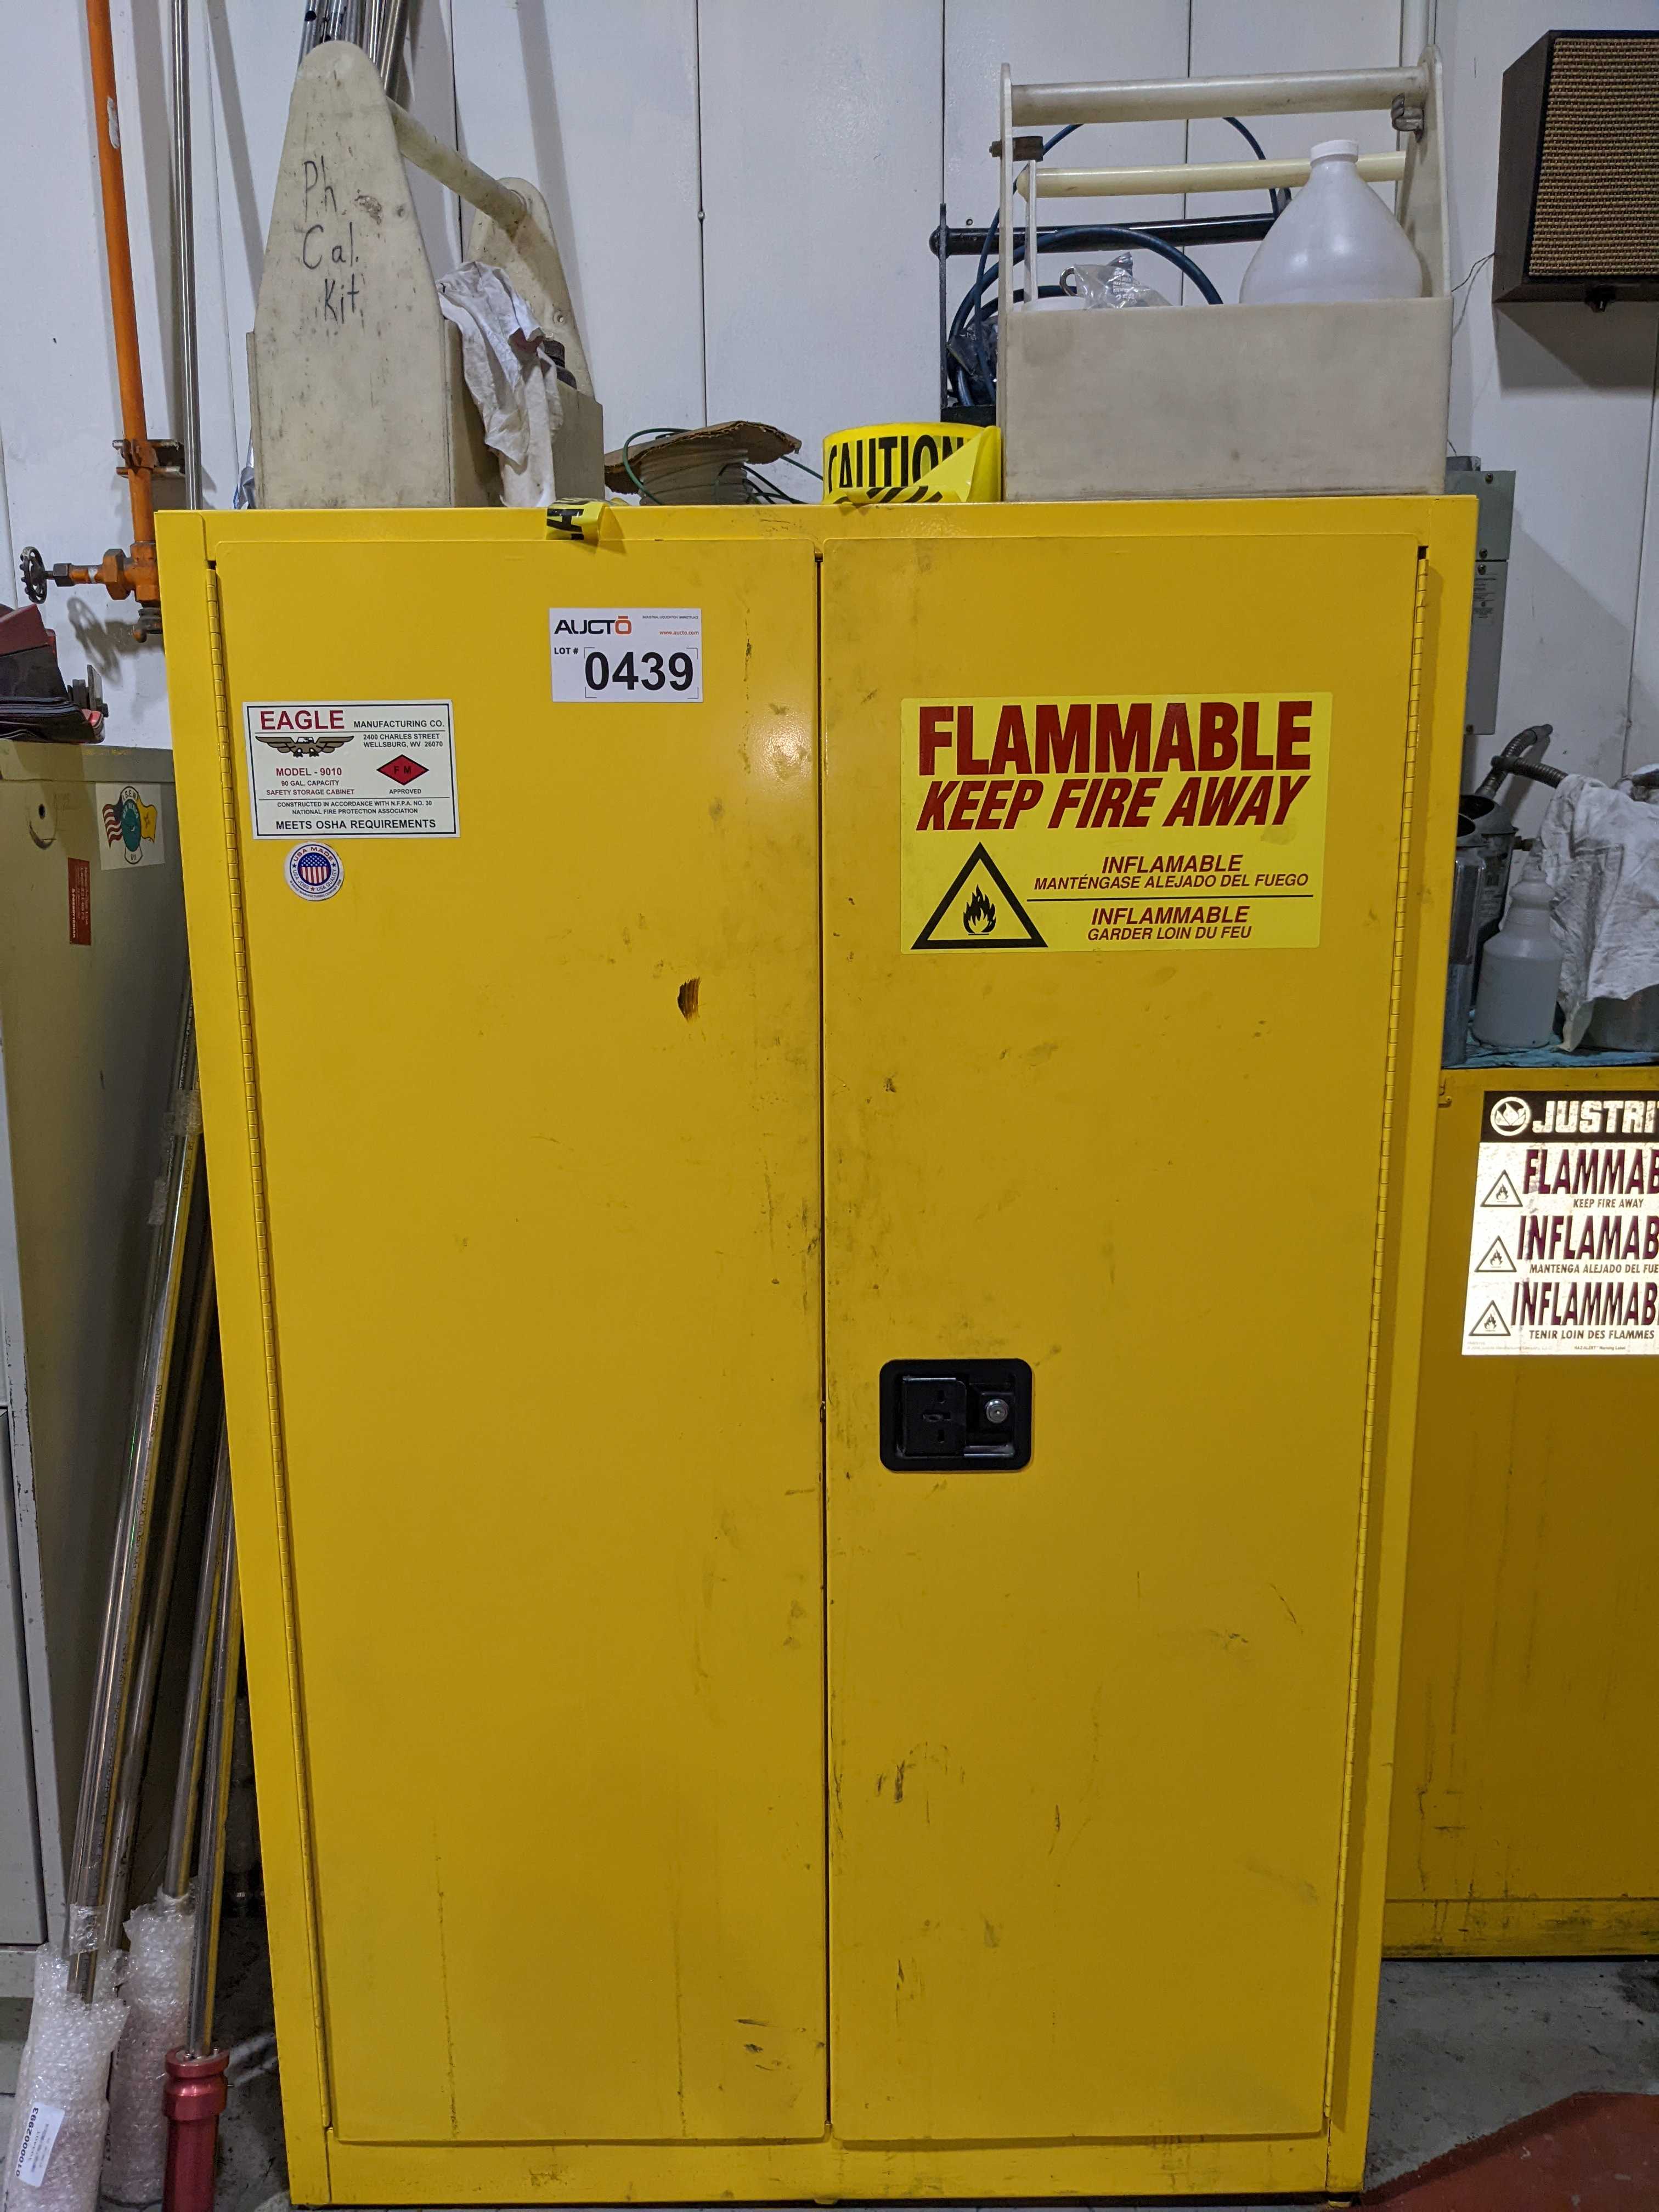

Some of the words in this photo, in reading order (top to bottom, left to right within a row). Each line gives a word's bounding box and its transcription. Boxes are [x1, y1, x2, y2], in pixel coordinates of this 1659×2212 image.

[325, 274, 359, 324] Kit
[585, 651, 693, 691] 0439
[260, 710, 345, 730] EAGLE
[918, 701, 1313, 776] FLAMMABLE
[276, 768, 312, 776] MODEL
[320, 768, 342, 776] 9010
[916, 779, 1044, 831] KEEP
[1047, 777, 1163, 830] FIRE
[1161, 775, 1312, 827] AWAY
[276, 821, 312, 830] MEETS
[316, 820, 347, 829] OSHA
[351, 819, 436, 829] REQUIREMENTS
[293, 849, 308, 862] USA
[311, 847, 334, 861] MADE
[1102, 854, 1244, 874] INFLAMABLE
[1034, 873, 1141, 890] MANTÉNGASE
[1143, 874, 1217, 889] ALEJADO
[1220, 873, 1250, 887] DEL
[1254, 873, 1309, 887] FUEGO
[1091, 906, 1251, 926] INFLAMMABLE
[1087, 927, 1155, 941] GARDER
[1156, 927, 1194, 940] LOIN
[1194, 927, 1220, 939] DU
[1220, 926, 1252, 939] FEU
[1532, 1101, 1659, 1133] JUSTRI
[1573, 1199, 1595, 1208] KEEP
[1597, 1199, 1616, 1208] FIRE
[1618, 1199, 1644, 1207] AWAY
[1517, 1215, 1659, 1260] INFLAMAB
[1530, 1264, 1580, 1273] MANTENGA
[1583, 1264, 1622, 1273] ALEJADO
[1624, 1264, 1640, 1273] DEL
[1511, 1282, 1659, 1326] INFLAMMAB
[1529, 1330, 1558, 1339] TENIR
[1561, 1330, 1584, 1339] LOIN
[1588, 1330, 1605, 1339] DES
[1609, 1330, 1655, 1339] FLAMMES
